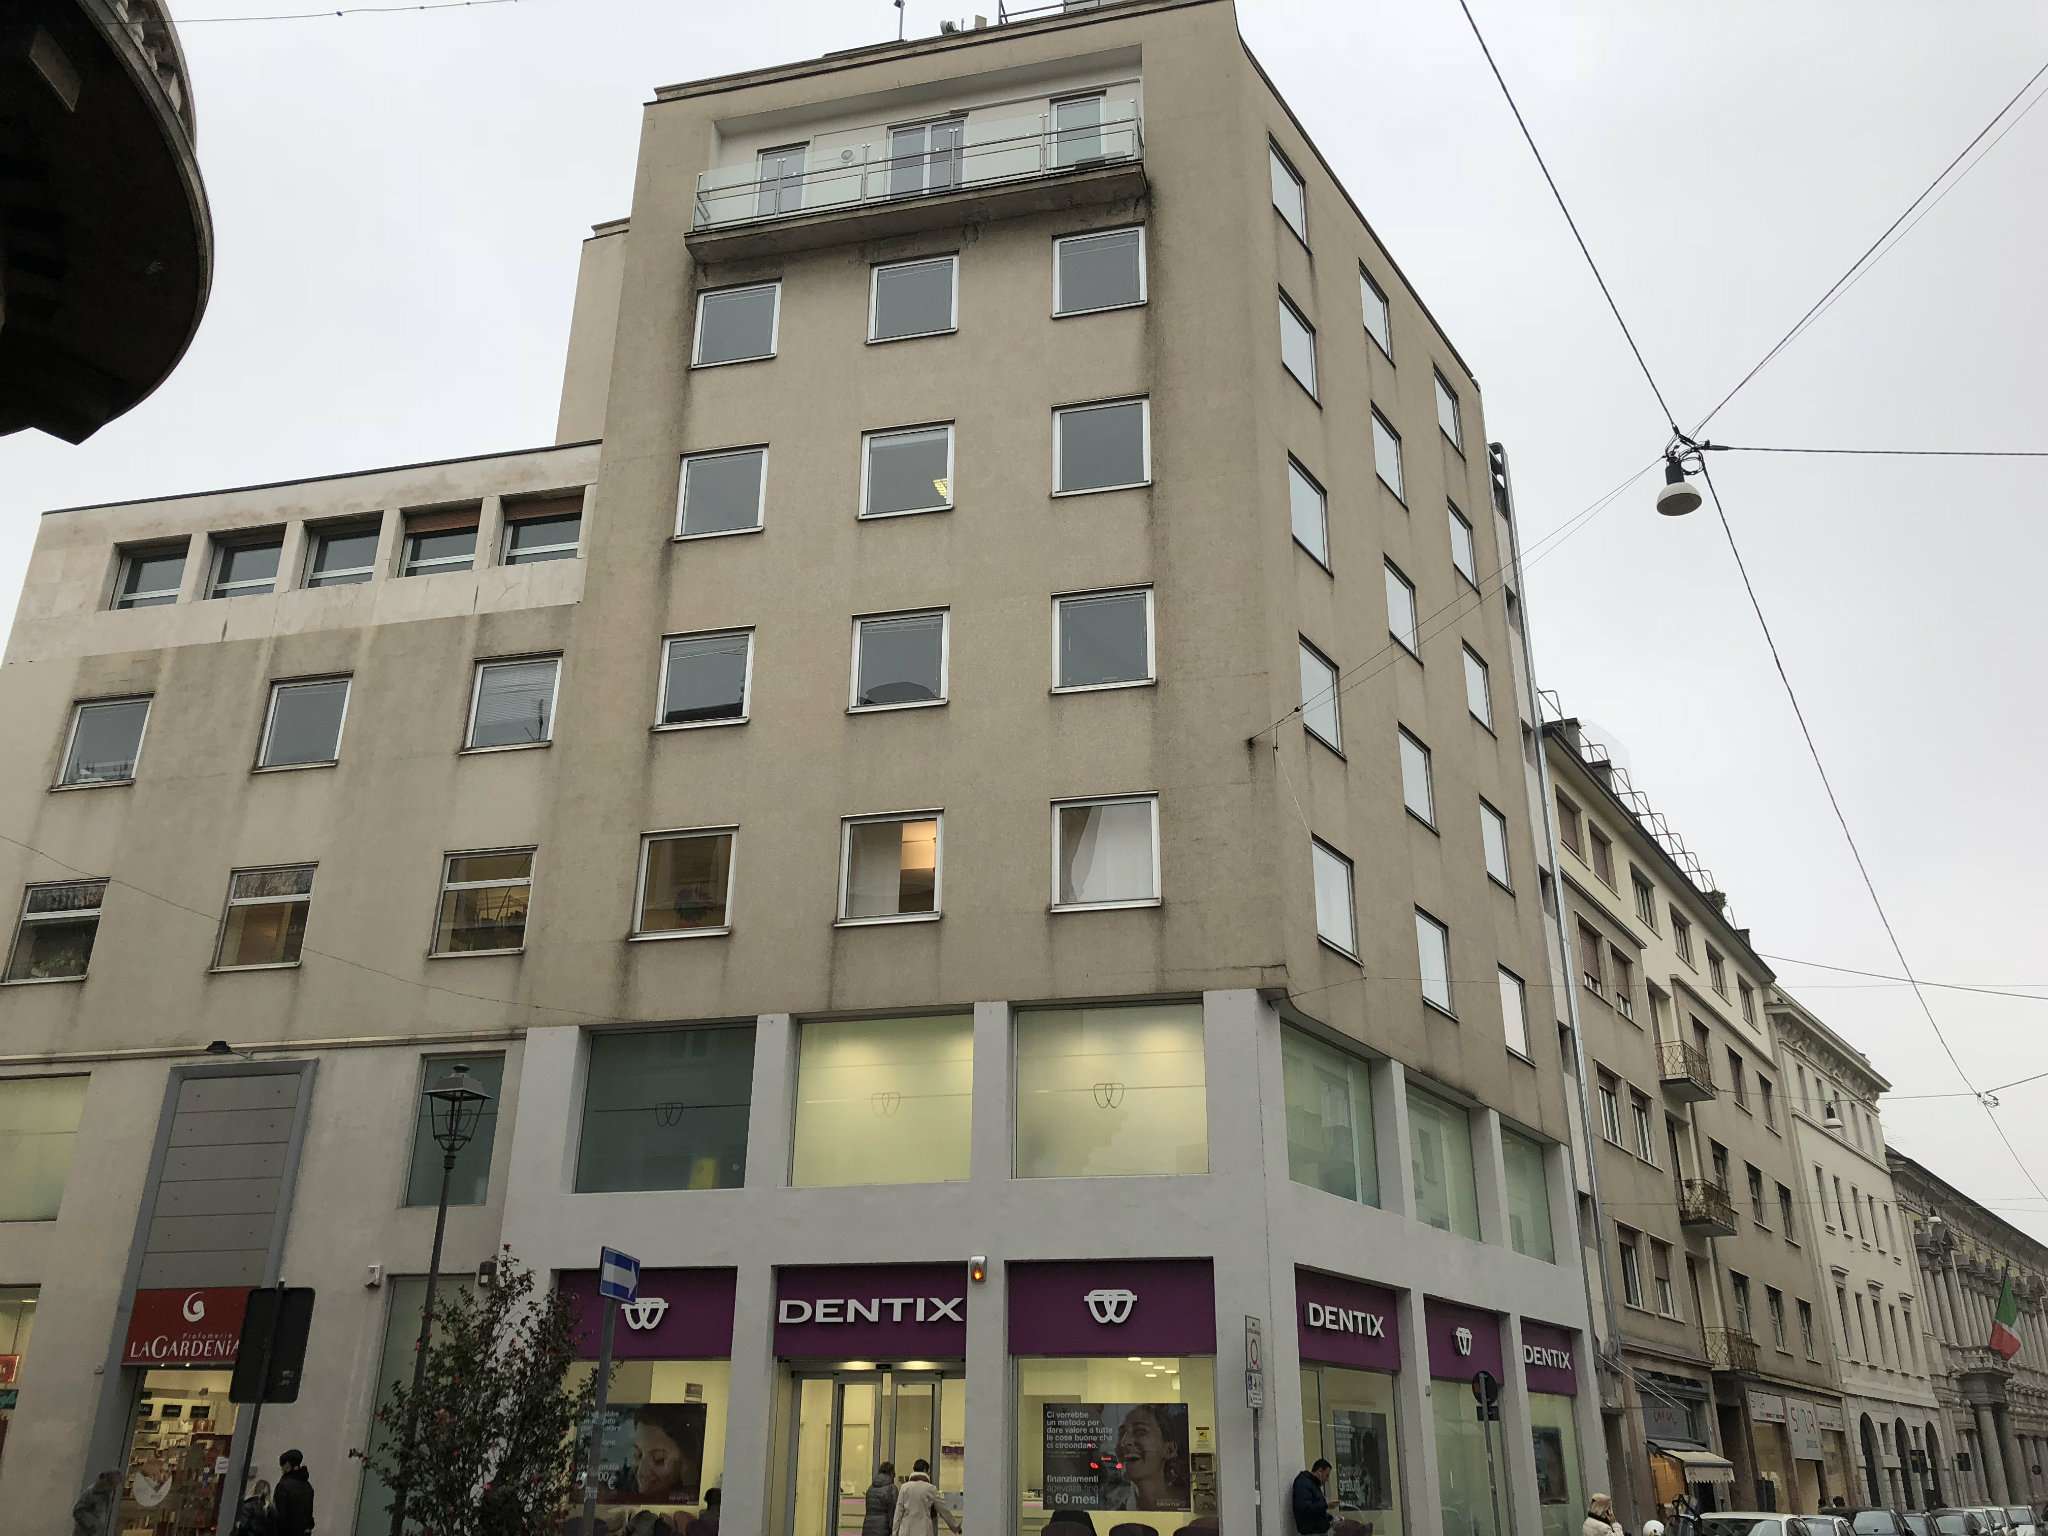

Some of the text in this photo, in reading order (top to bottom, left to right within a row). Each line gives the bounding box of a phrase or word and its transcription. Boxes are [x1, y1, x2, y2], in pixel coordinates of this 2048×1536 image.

[778, 1296, 965, 1325] DENTIX
[1308, 1302, 1386, 1338] DENTIX
[1523, 1343, 1572, 1371] DENTIX
[1046, 1411, 1055, 1419] Ci
[1046, 1474, 1099, 1483] finanziamenti
[1055, 1493, 1069, 1505] 60
[1071, 1493, 1099, 1505] mesi
